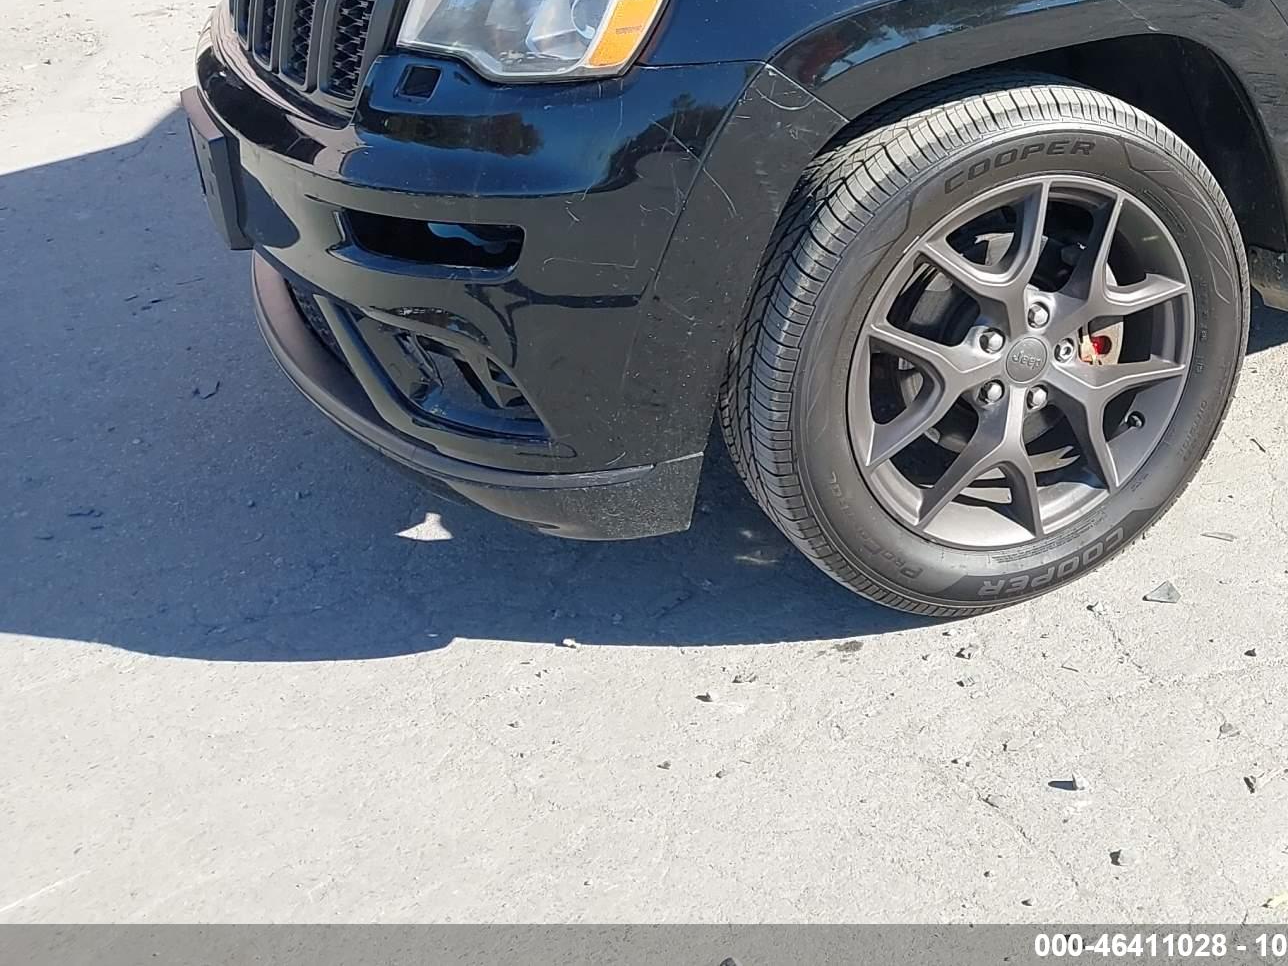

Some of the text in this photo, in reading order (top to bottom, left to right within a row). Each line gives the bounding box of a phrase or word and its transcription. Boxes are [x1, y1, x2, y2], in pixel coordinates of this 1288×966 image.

[943, 139, 1096, 195] COOPER
[1011, 349, 1042, 370] Jeep
[976, 526, 1125, 597] COOPER
